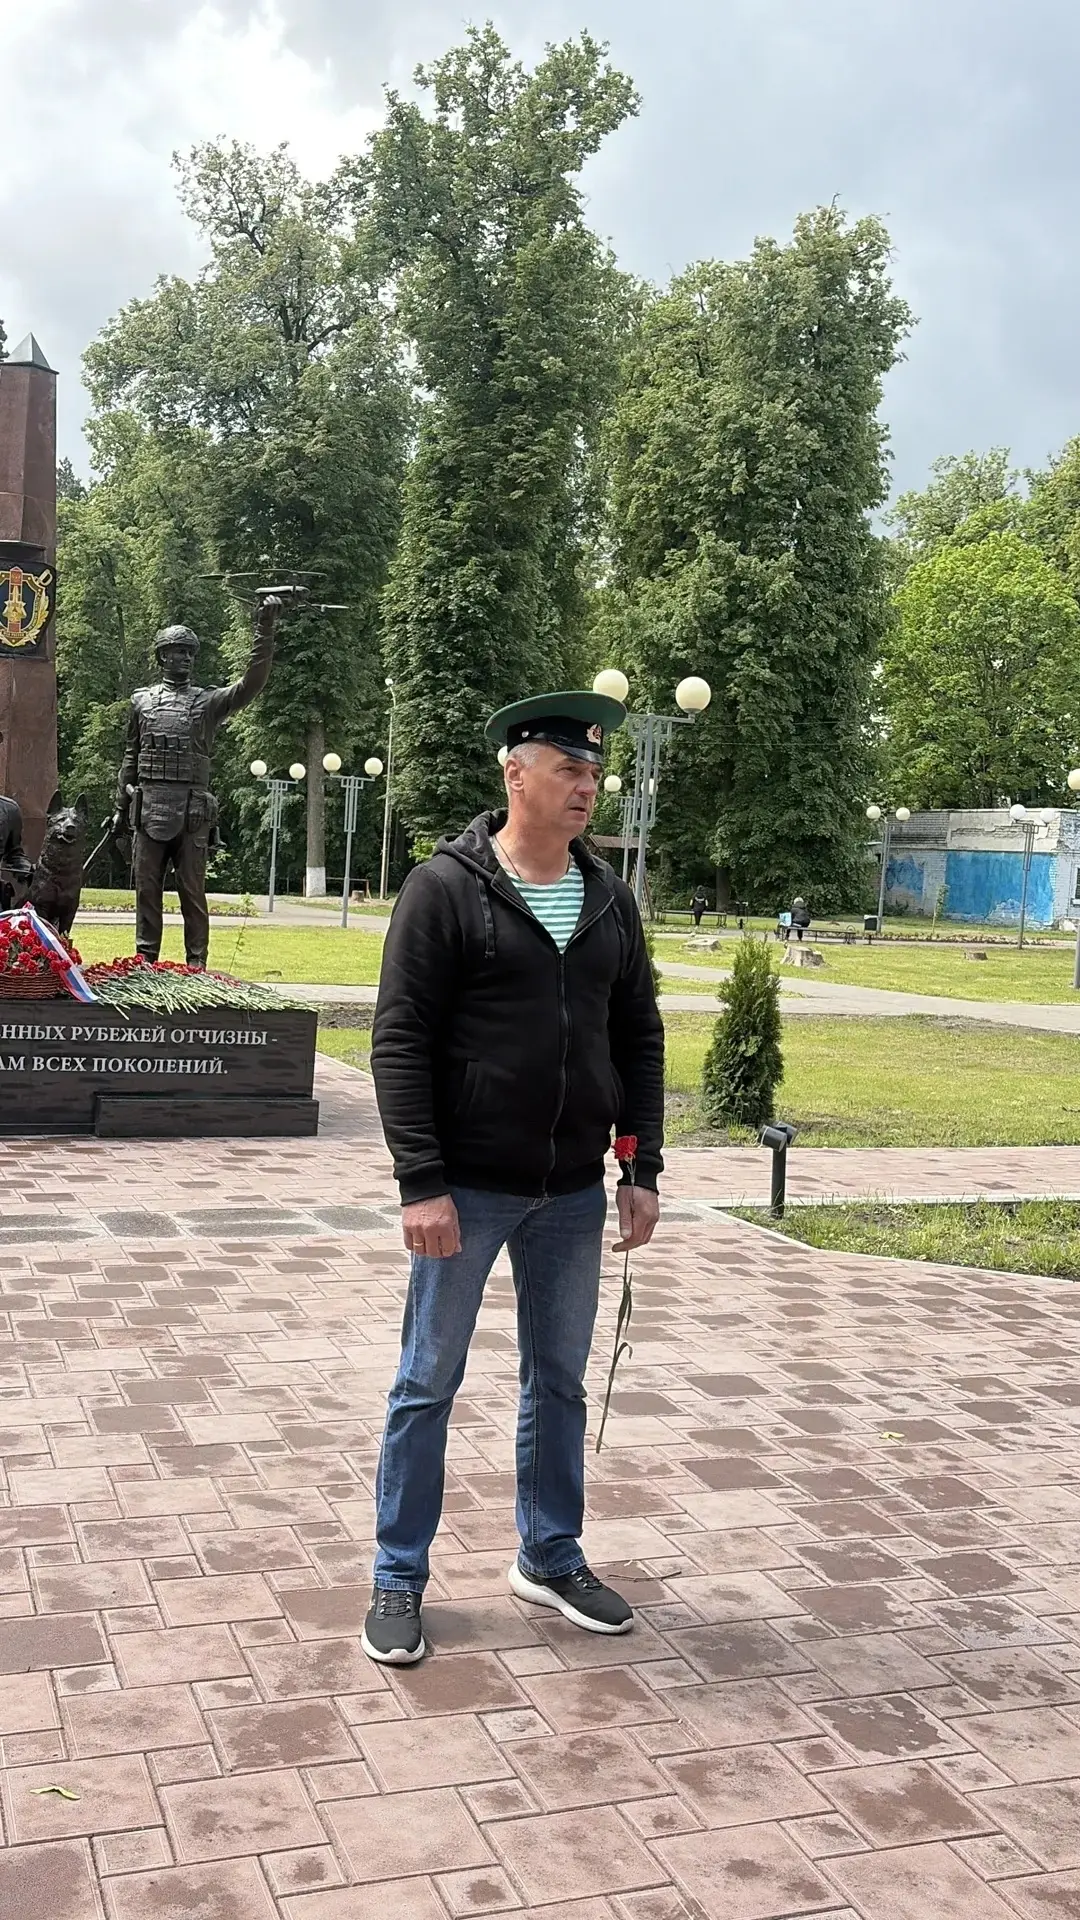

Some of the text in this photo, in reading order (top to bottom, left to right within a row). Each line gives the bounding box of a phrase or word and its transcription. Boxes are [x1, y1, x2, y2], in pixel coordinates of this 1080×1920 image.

[0, 1024, 67, 1041] ННЫХ
[70, 1025, 167, 1043] РУБЕЖЕЙ
[170, 1028, 268, 1045] ОТЧИЗНЫ
[32, 1056, 87, 1072] ВСЕХ
[92, 1057, 229, 1075] ПОКОЛЕНИЙ.
